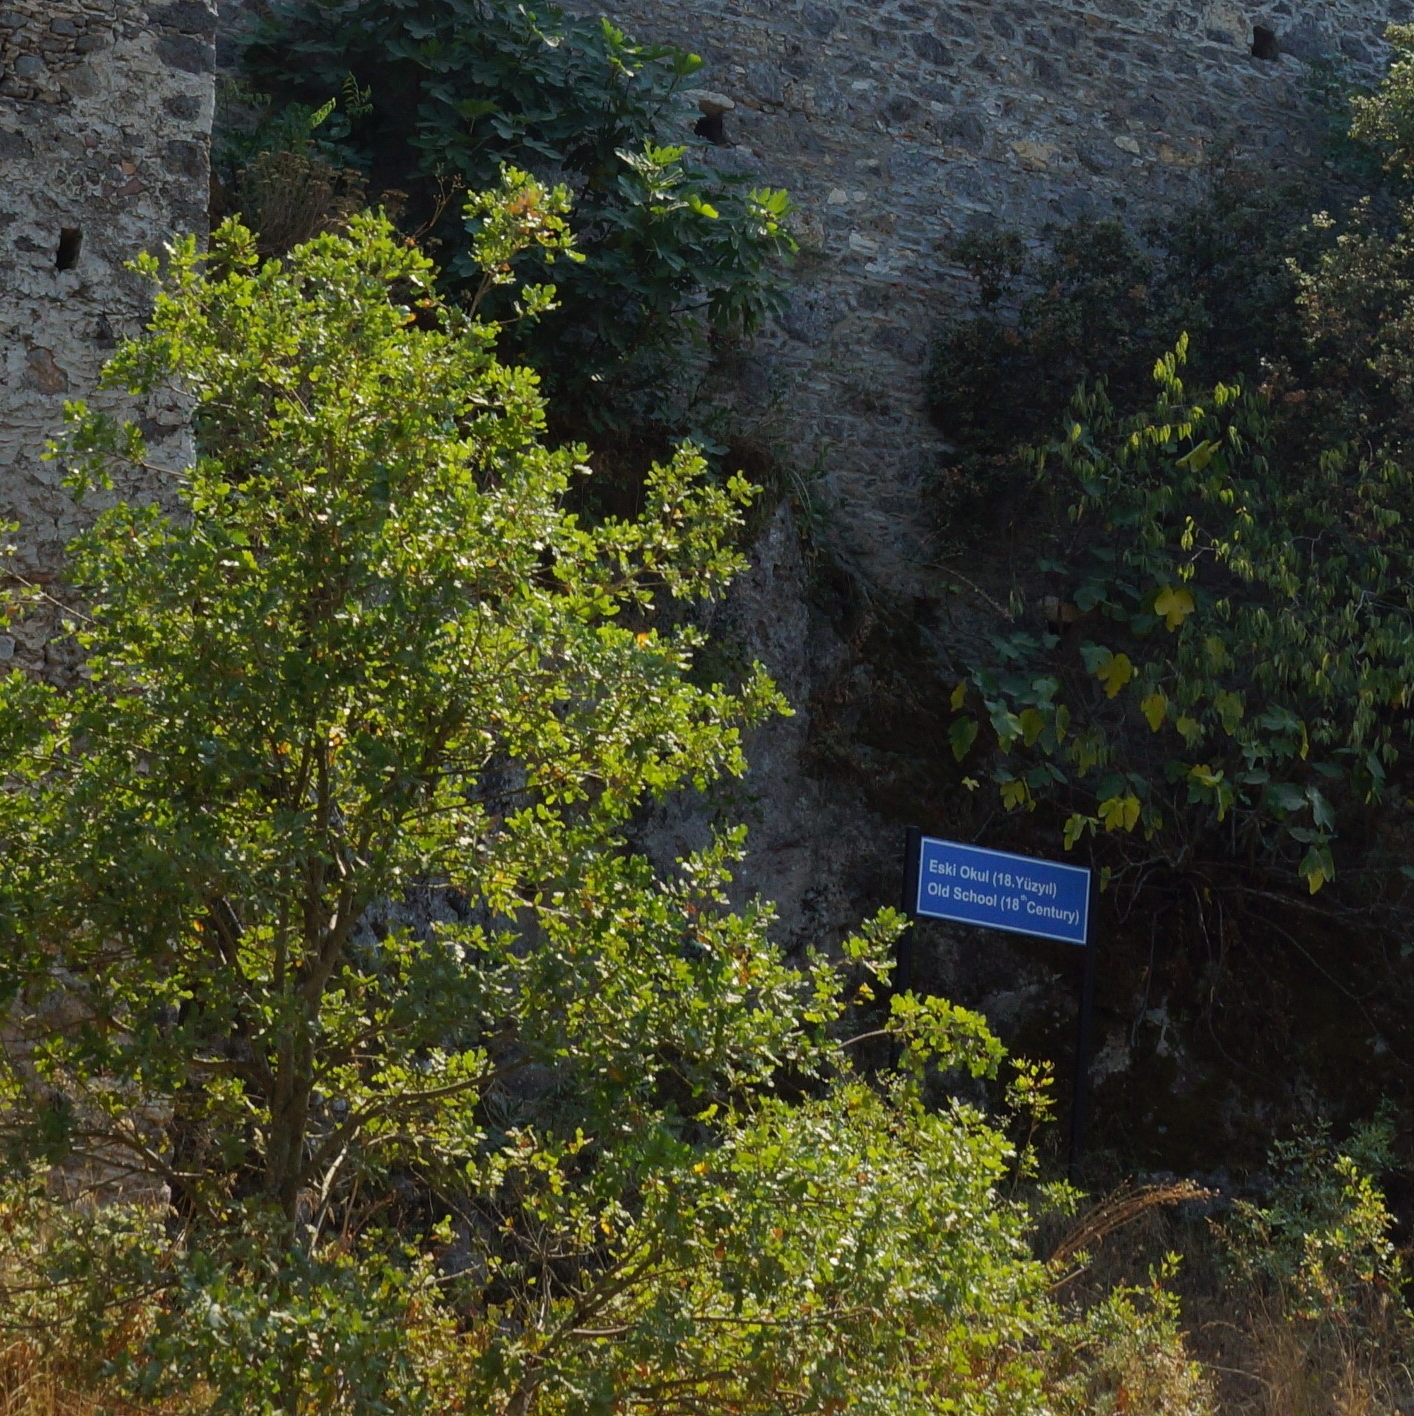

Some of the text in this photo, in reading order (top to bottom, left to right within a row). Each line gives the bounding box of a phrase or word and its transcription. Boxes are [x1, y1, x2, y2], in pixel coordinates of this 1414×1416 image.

[929, 859, 957, 876] Eski
[960, 865, 989, 884] Okul
[927, 882, 950, 898] Old
[953, 887, 997, 907] School
[1026, 900, 1079, 925] Century)
